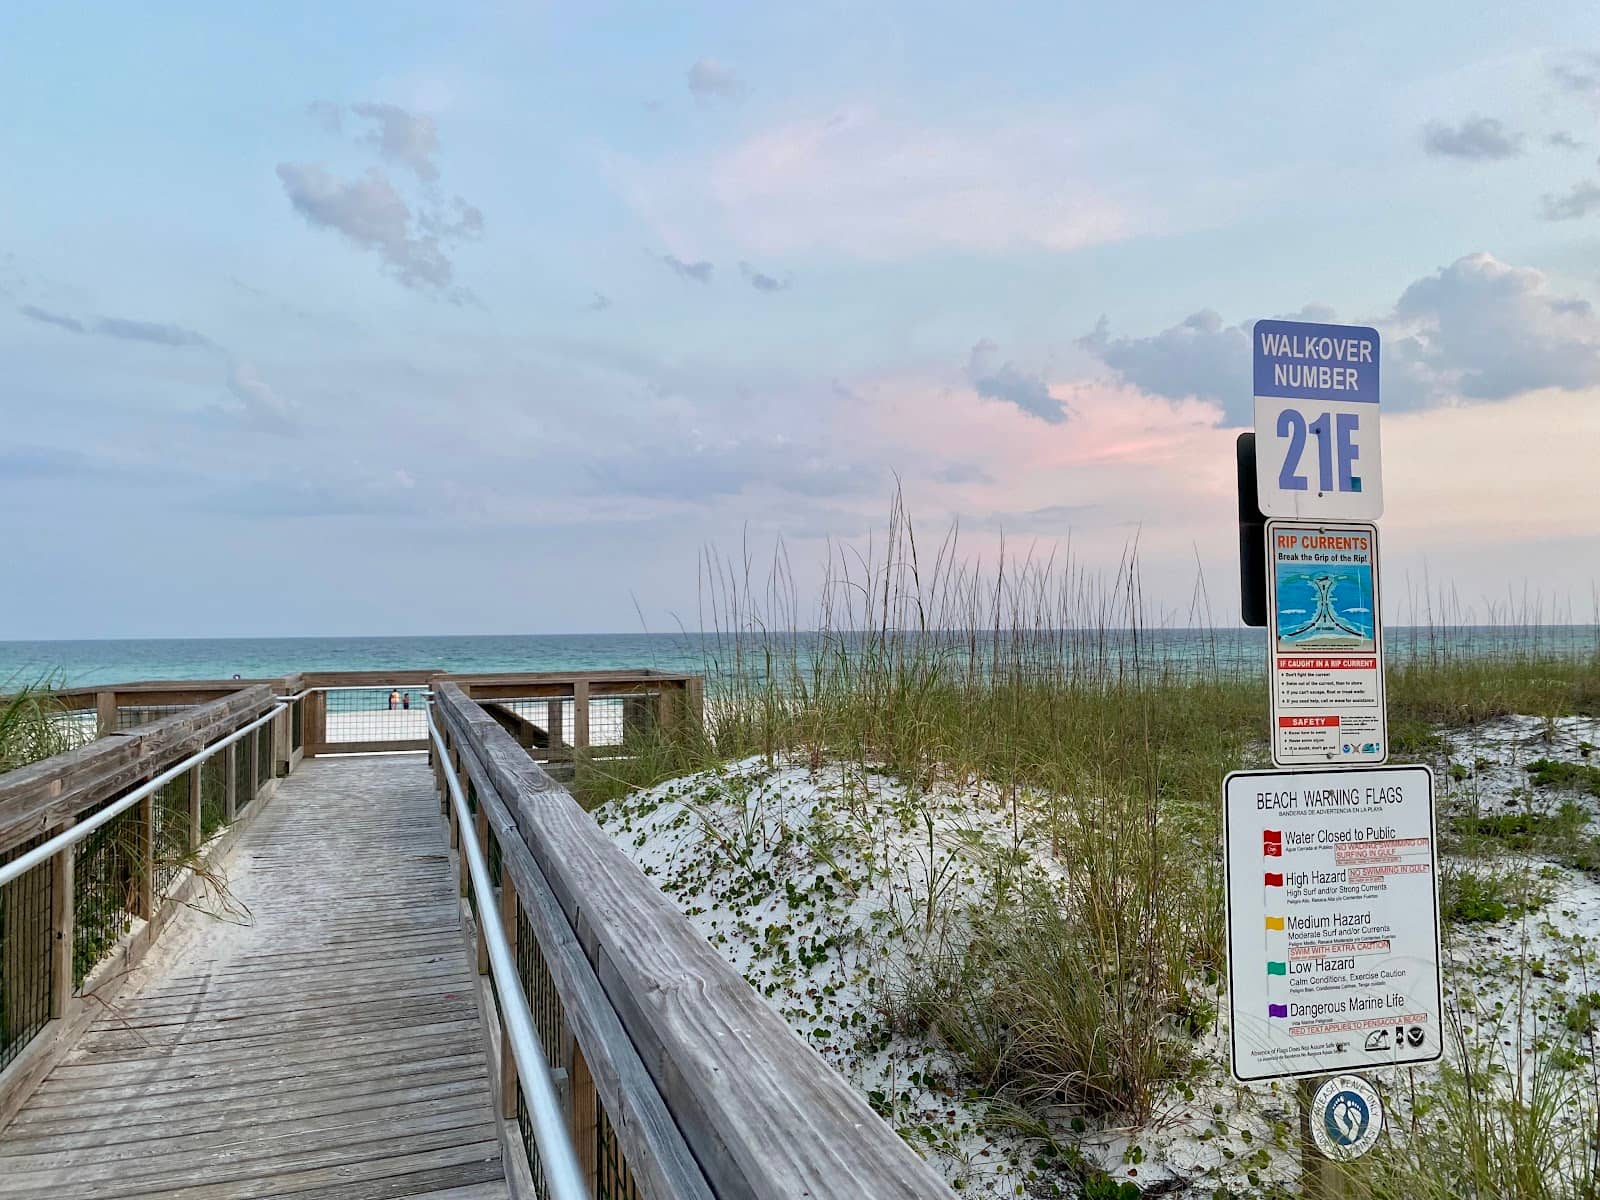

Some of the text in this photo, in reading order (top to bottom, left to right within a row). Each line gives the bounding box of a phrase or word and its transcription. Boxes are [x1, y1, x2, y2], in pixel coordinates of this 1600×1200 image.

[1261, 333, 1373, 363] WALKOVER
[1274, 364, 1359, 391] NUMBER
[1276, 408, 1362, 492] 21E
[1278, 535, 1368, 550] RIP CURRENTS
[1278, 553, 1368, 564] Break the Grip of the Rip!
[1292, 718, 1326, 726] SAFETY
[1257, 786, 1403, 810] BEACH WARNING FLAGS
[1316, 807, 1352, 815] ADVERTENCIA
[1285, 826, 1396, 845] Water Closed to Public
[1337, 851, 1368, 859] SURFING
[1286, 869, 1346, 888] High Hazard
[1362, 867, 1399, 876] SWIMMING
[1286, 889, 1302, 898] High
[1303, 888, 1317, 896] Surf
[1339, 885, 1360, 894] Strong
[1361, 884, 1387, 892] Currents
[1288, 911, 1371, 930] Medium Hazard
[1288, 925, 1391, 940] Moderate Surf and/or Currents
[1290, 941, 1388, 956] SWIM WITH EXTRA CAUTION
[1289, 956, 1355, 974] Low Hazard
[1290, 978, 1308, 987] Calm
[1350, 973, 1378, 981] Exercise
[1380, 970, 1406, 978] Caution
[1290, 993, 1404, 1018] Dangerous Marine Life
[1307, 1026, 1325, 1034] TEXT
[1324, 1024, 1352, 1032] APPLIES
[1363, 1019, 1402, 1029] PENSACOLA
[1404, 1015, 1426, 1024] BEACH
[1367, 1095, 1378, 1116] ONLY
